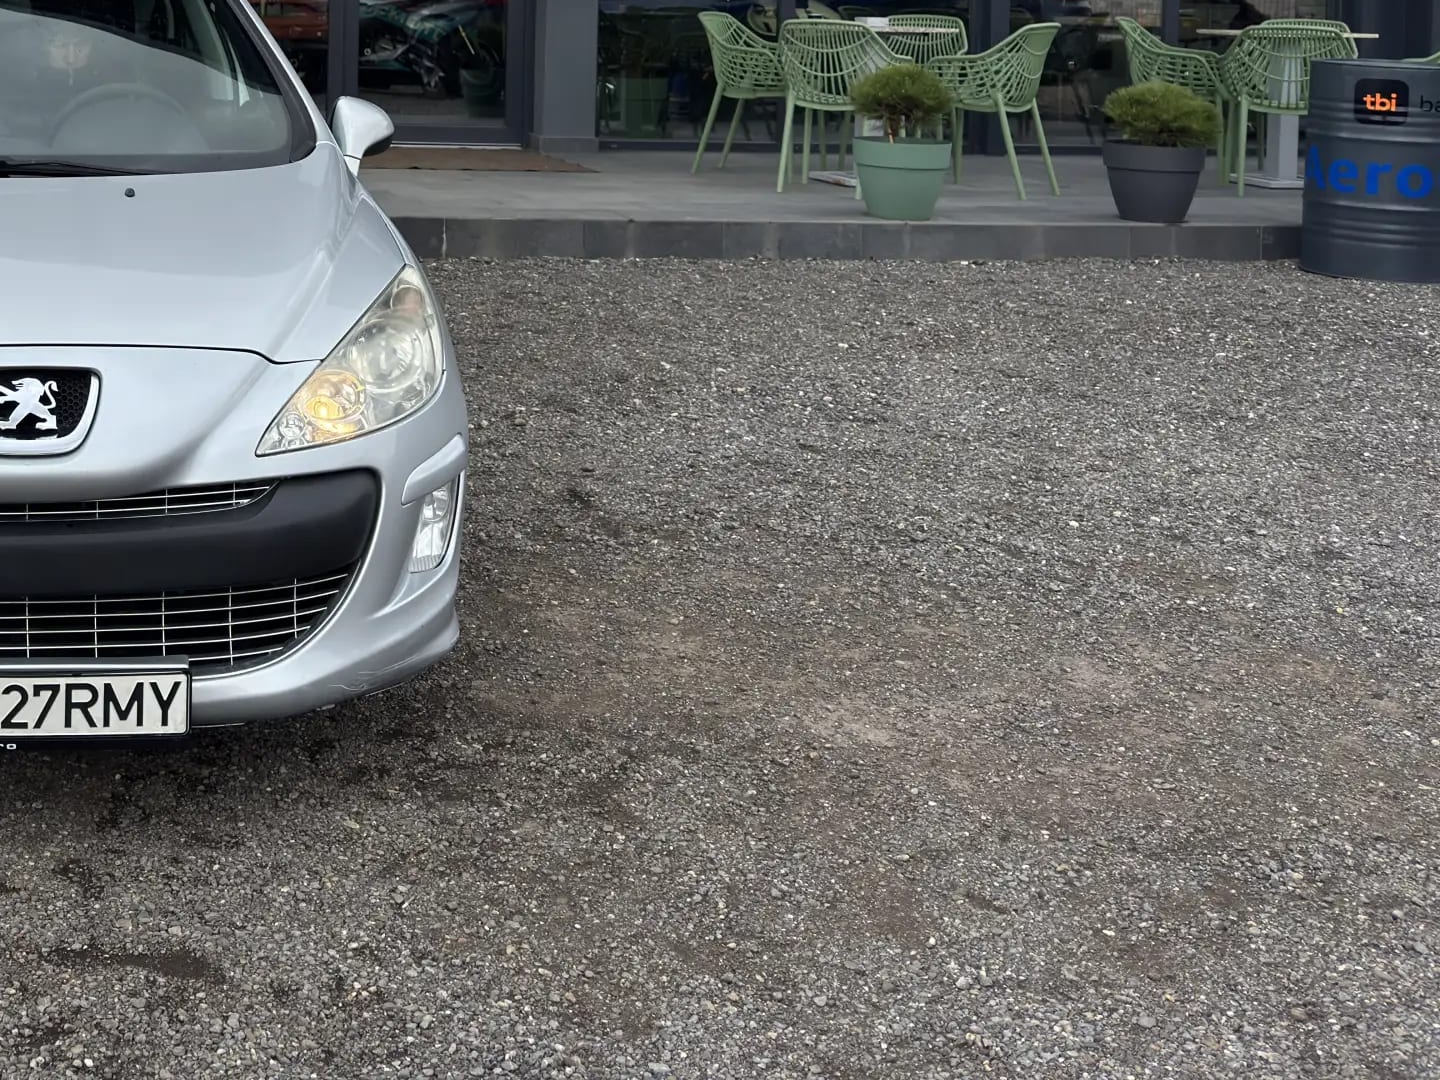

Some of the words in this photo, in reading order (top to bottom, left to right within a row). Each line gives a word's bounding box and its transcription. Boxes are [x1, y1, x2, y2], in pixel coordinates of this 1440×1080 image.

[1363, 93, 1397, 112] tbi
[1306, 143, 1440, 199] Aero
[0, 681, 182, 730] 27RMY
